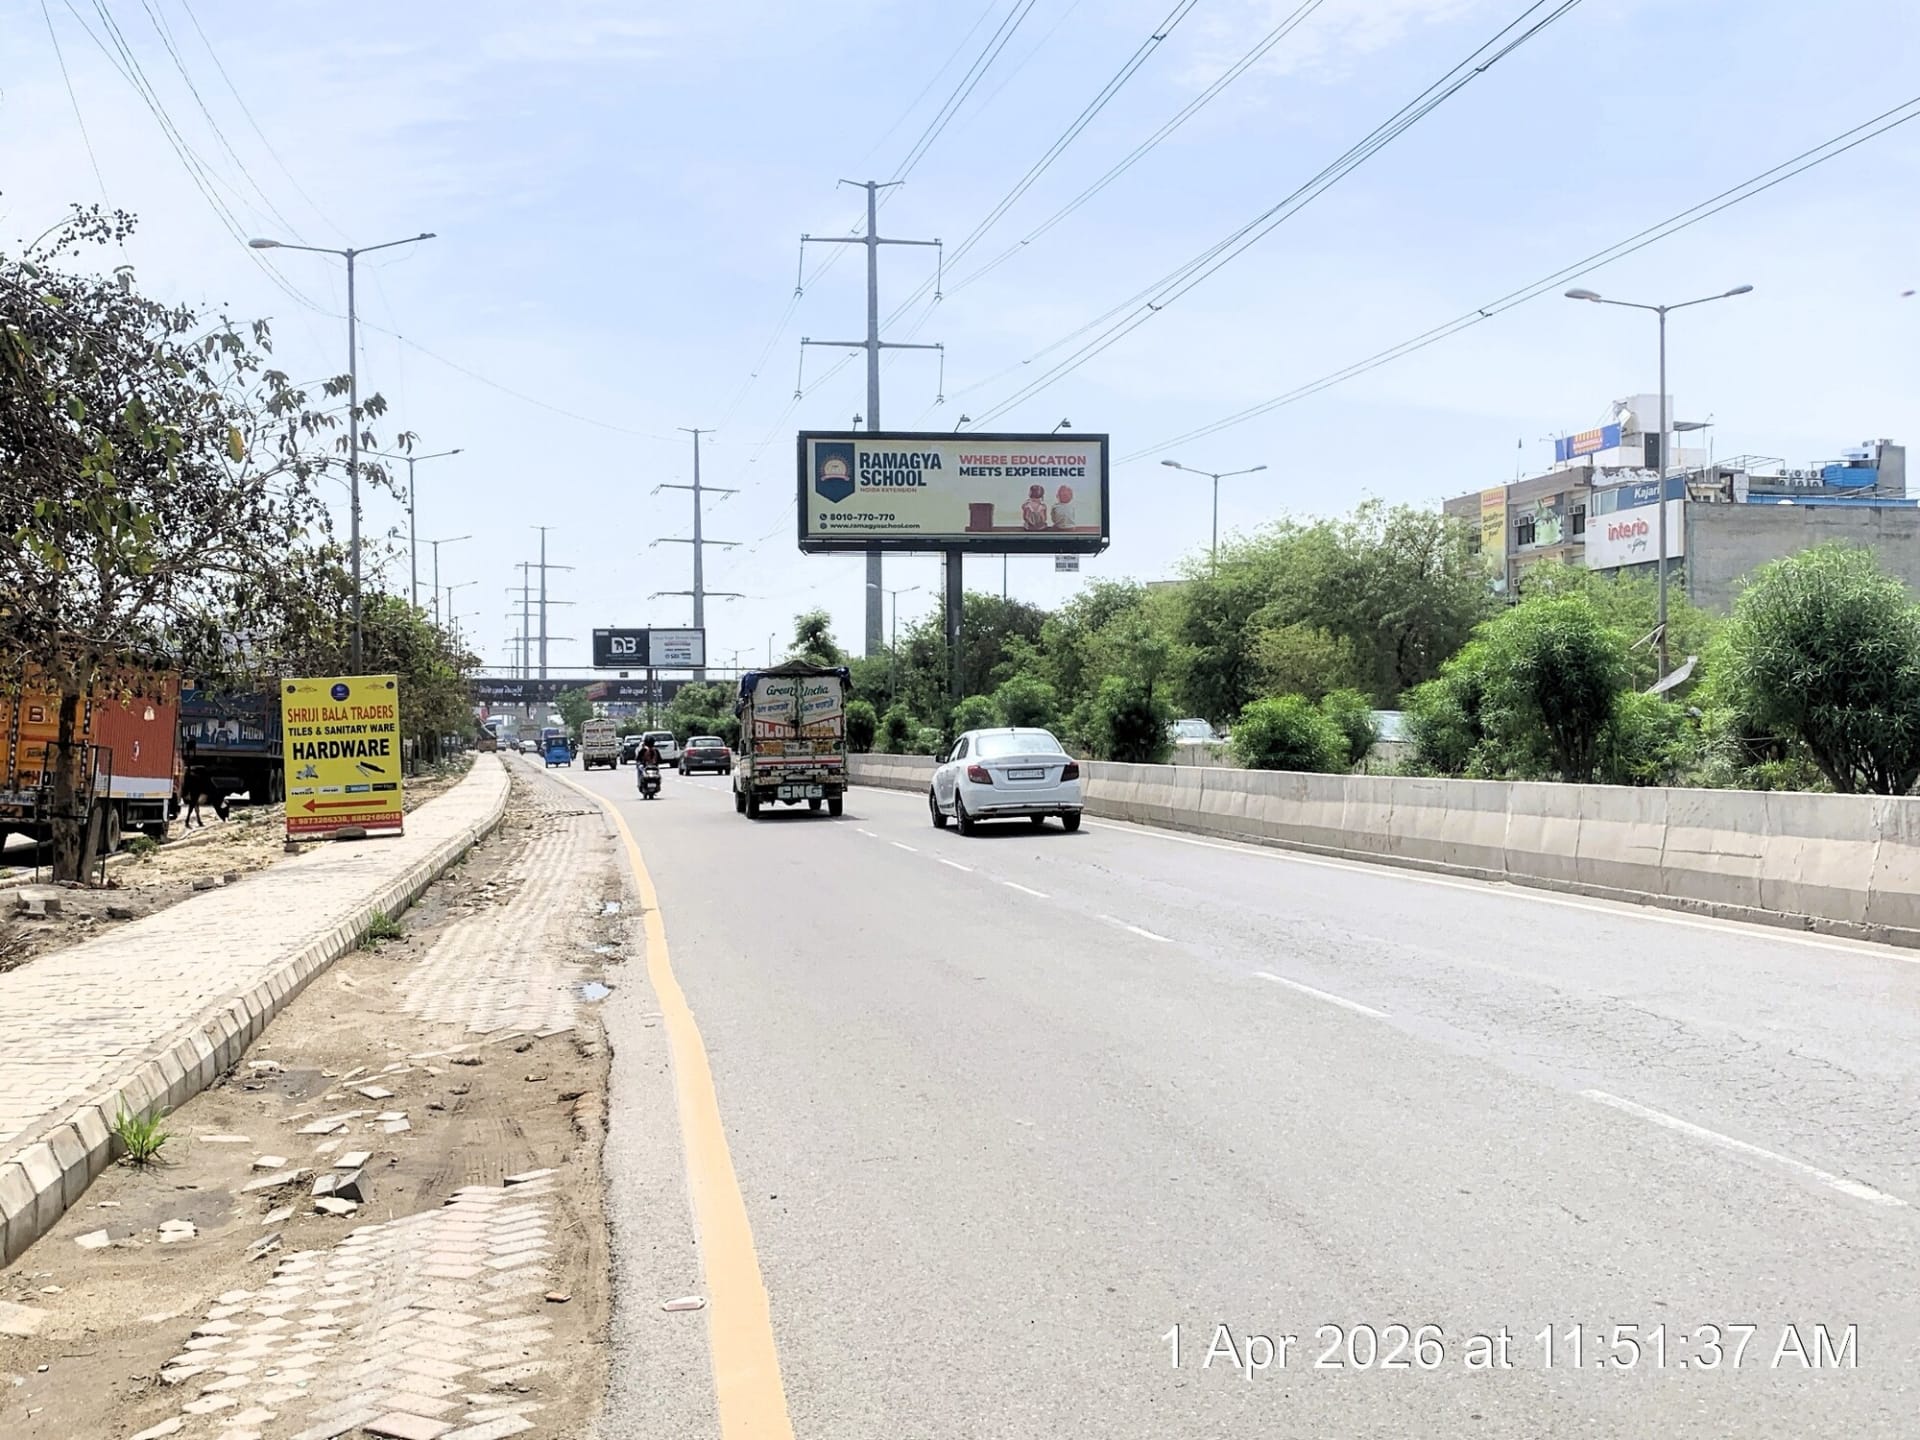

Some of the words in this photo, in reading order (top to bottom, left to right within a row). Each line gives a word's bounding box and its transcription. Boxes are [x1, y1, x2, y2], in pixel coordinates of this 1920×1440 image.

[860, 453, 942, 469] RAMAGYA
[959, 455, 1008, 465] WHERE
[1011, 455, 1087, 466] EDUCATION
[860, 470, 927, 486] SCHOOL
[959, 467, 1002, 476] MEETS
[1005, 467, 1085, 477] EXPERIENCE
[830, 513, 896, 521] 8010-770-770
[1607, 517, 1649, 541] interio
[287, 707, 319, 723] SHRIJI
[322, 706, 349, 722] BALA
[350, 704, 394, 720] TRADERS
[241, 726, 265, 740] HORN
[288, 726, 313, 737] TILES
[315, 726, 322, 736] &
[324, 724, 368, 735] SANITARY
[369, 723, 395, 733] WARE
[755, 721, 796, 738] BLOW
[292, 738, 390, 760] HARDWARE
[777, 785, 823, 799] CNG
